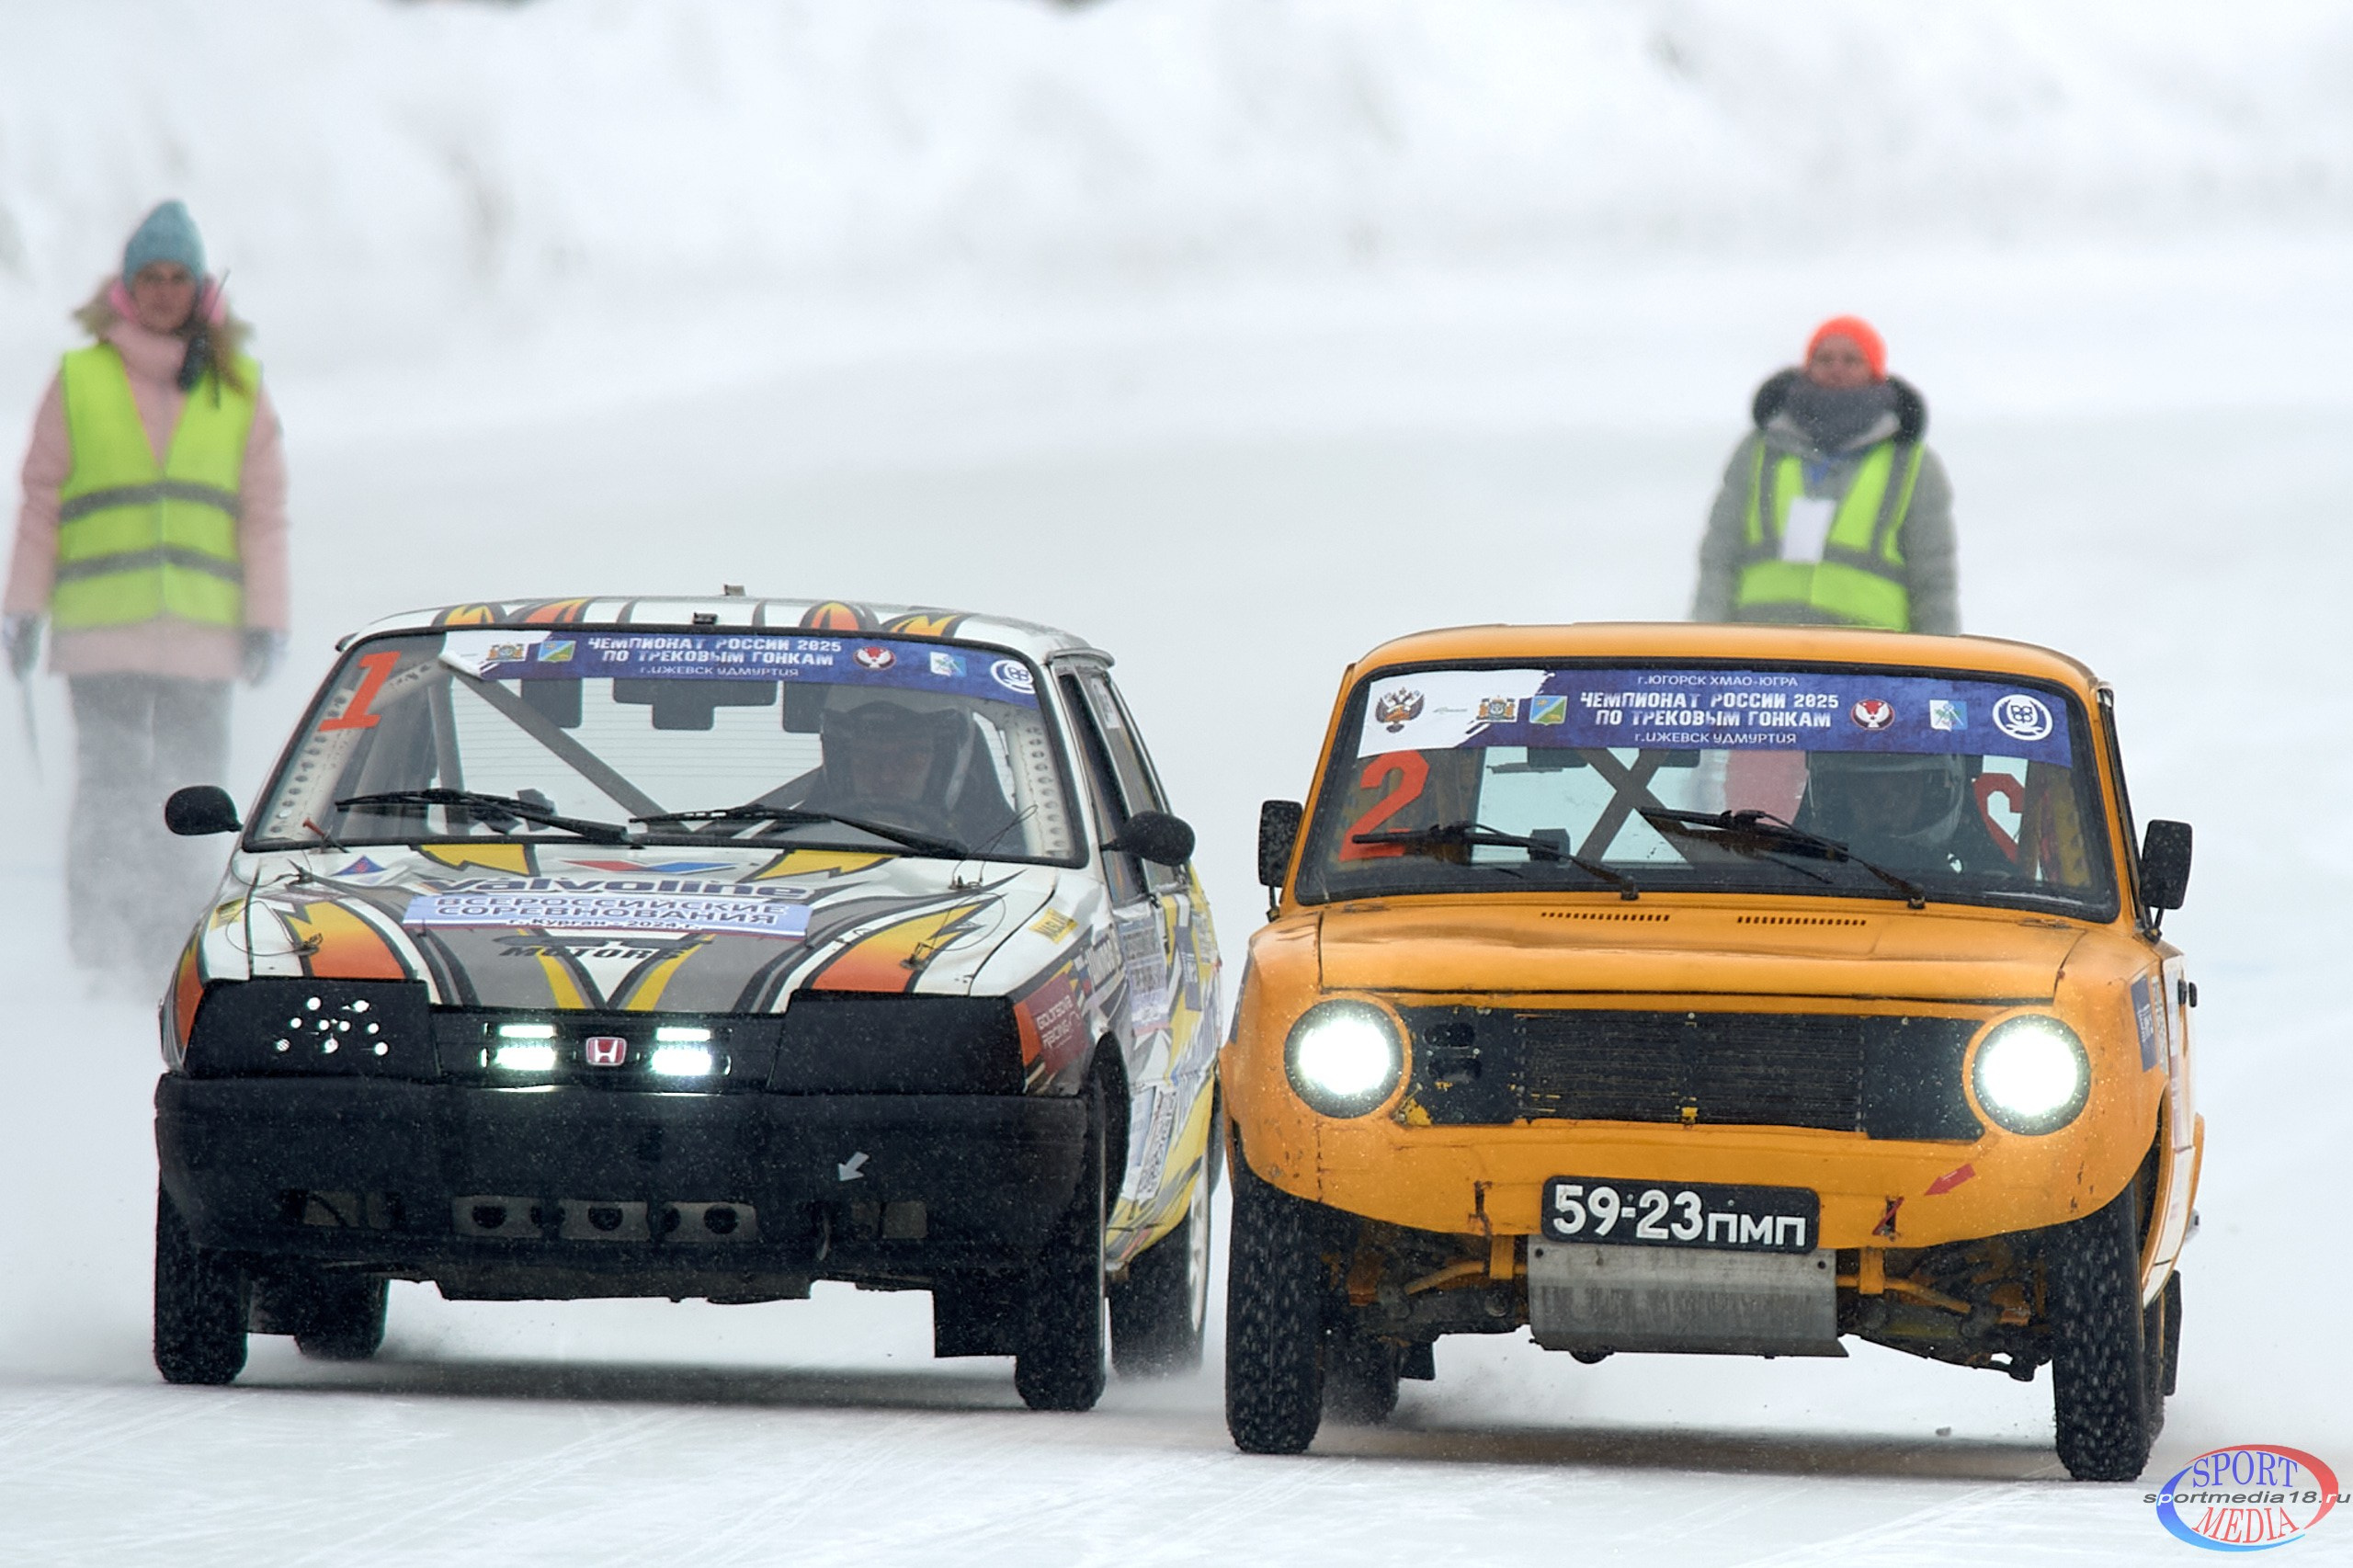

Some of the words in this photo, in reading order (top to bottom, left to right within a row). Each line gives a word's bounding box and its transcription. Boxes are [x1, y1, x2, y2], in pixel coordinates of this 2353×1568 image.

[588, 637, 706, 650] ЧЕМПИОНАТ
[715, 638, 790, 651] РОССИИ
[798, 640, 842, 652] 2025
[602, 650, 631, 662] ПО
[638, 651, 745, 664] ТРЕКОВЫМ
[752, 652, 835, 665] ГОНКАМ
[717, 667, 799, 676] УДМУРТИЯ
[1710, 676, 1799, 687] ХМАО-ЮГРА
[318, 651, 401, 732] 1
[1580, 692, 1700, 708] ЧЕМПИОНАТ
[1710, 693, 1786, 709] РОССИИ
[1793, 694, 1839, 709] 2025
[1595, 710, 1623, 725] ПО
[1631, 710, 1740, 726] ТРЕКОВЫМ
[1747, 711, 1832, 727] ГОНКАМ
[1713, 733, 1797, 744] УДМУРТИЯ
[1338, 749, 1429, 863] 2
[437, 897, 787, 915] ВСЕРОССИЙСКИЕ
[437, 906, 776, 925] СОРЕВНОВАНИЯ
